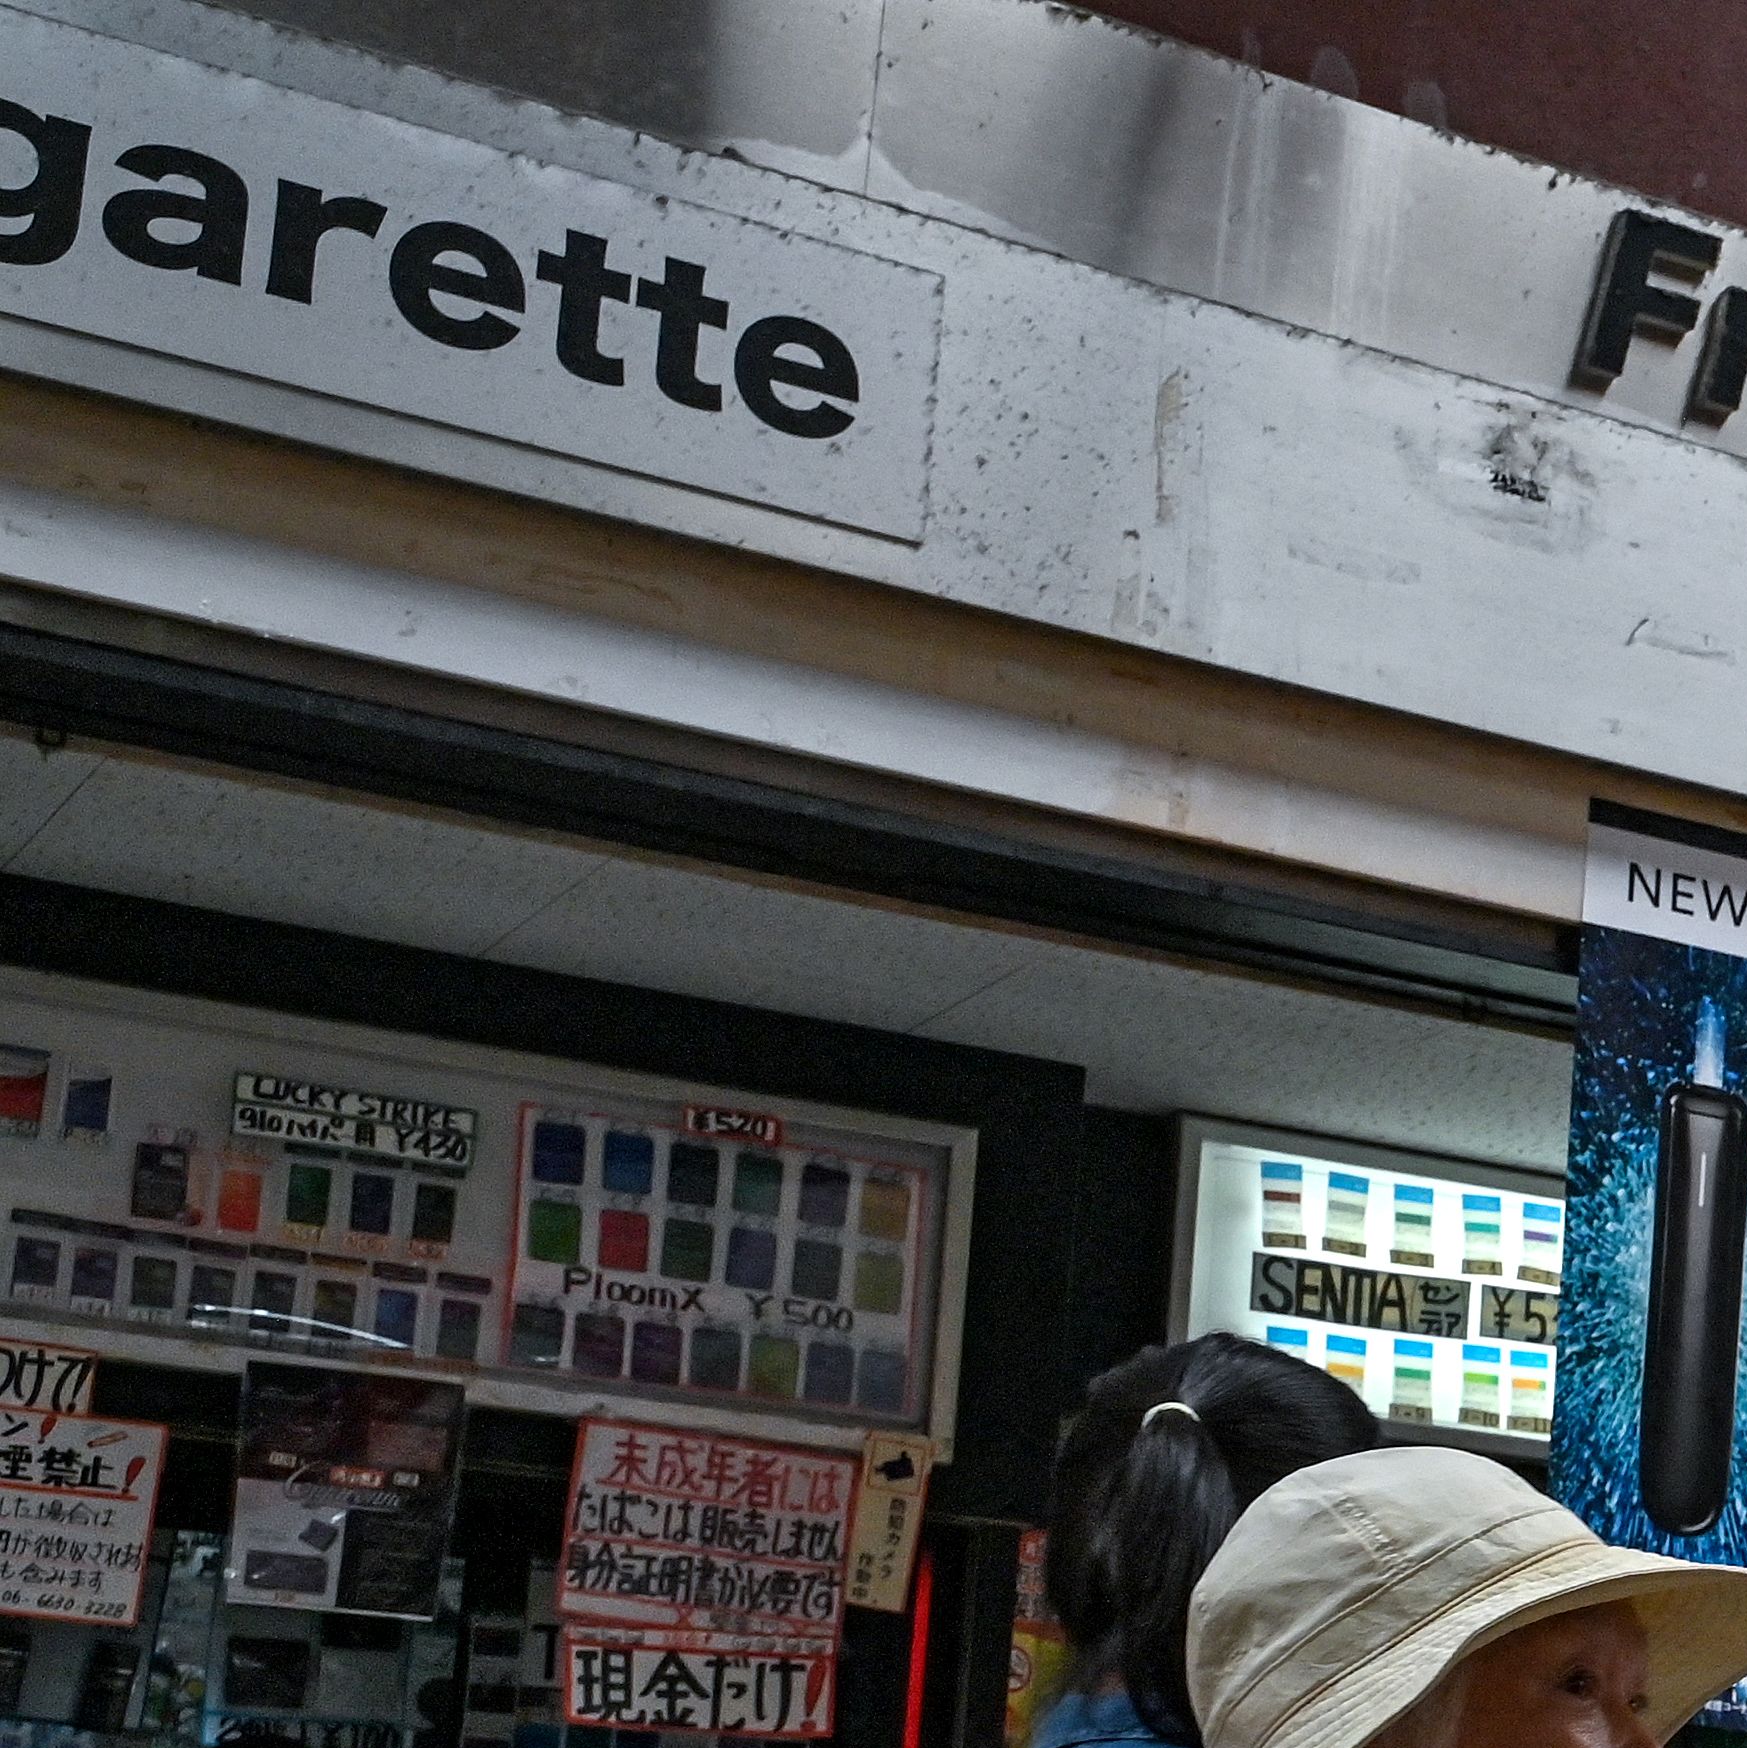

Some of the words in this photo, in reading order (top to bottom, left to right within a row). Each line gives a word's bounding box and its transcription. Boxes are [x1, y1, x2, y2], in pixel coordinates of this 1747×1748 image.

[1258, 1254, 1407, 1333] SENTIA
[598, 1434, 842, 1512] 未成年者には
[574, 1648, 828, 1734] 現金だけ!
